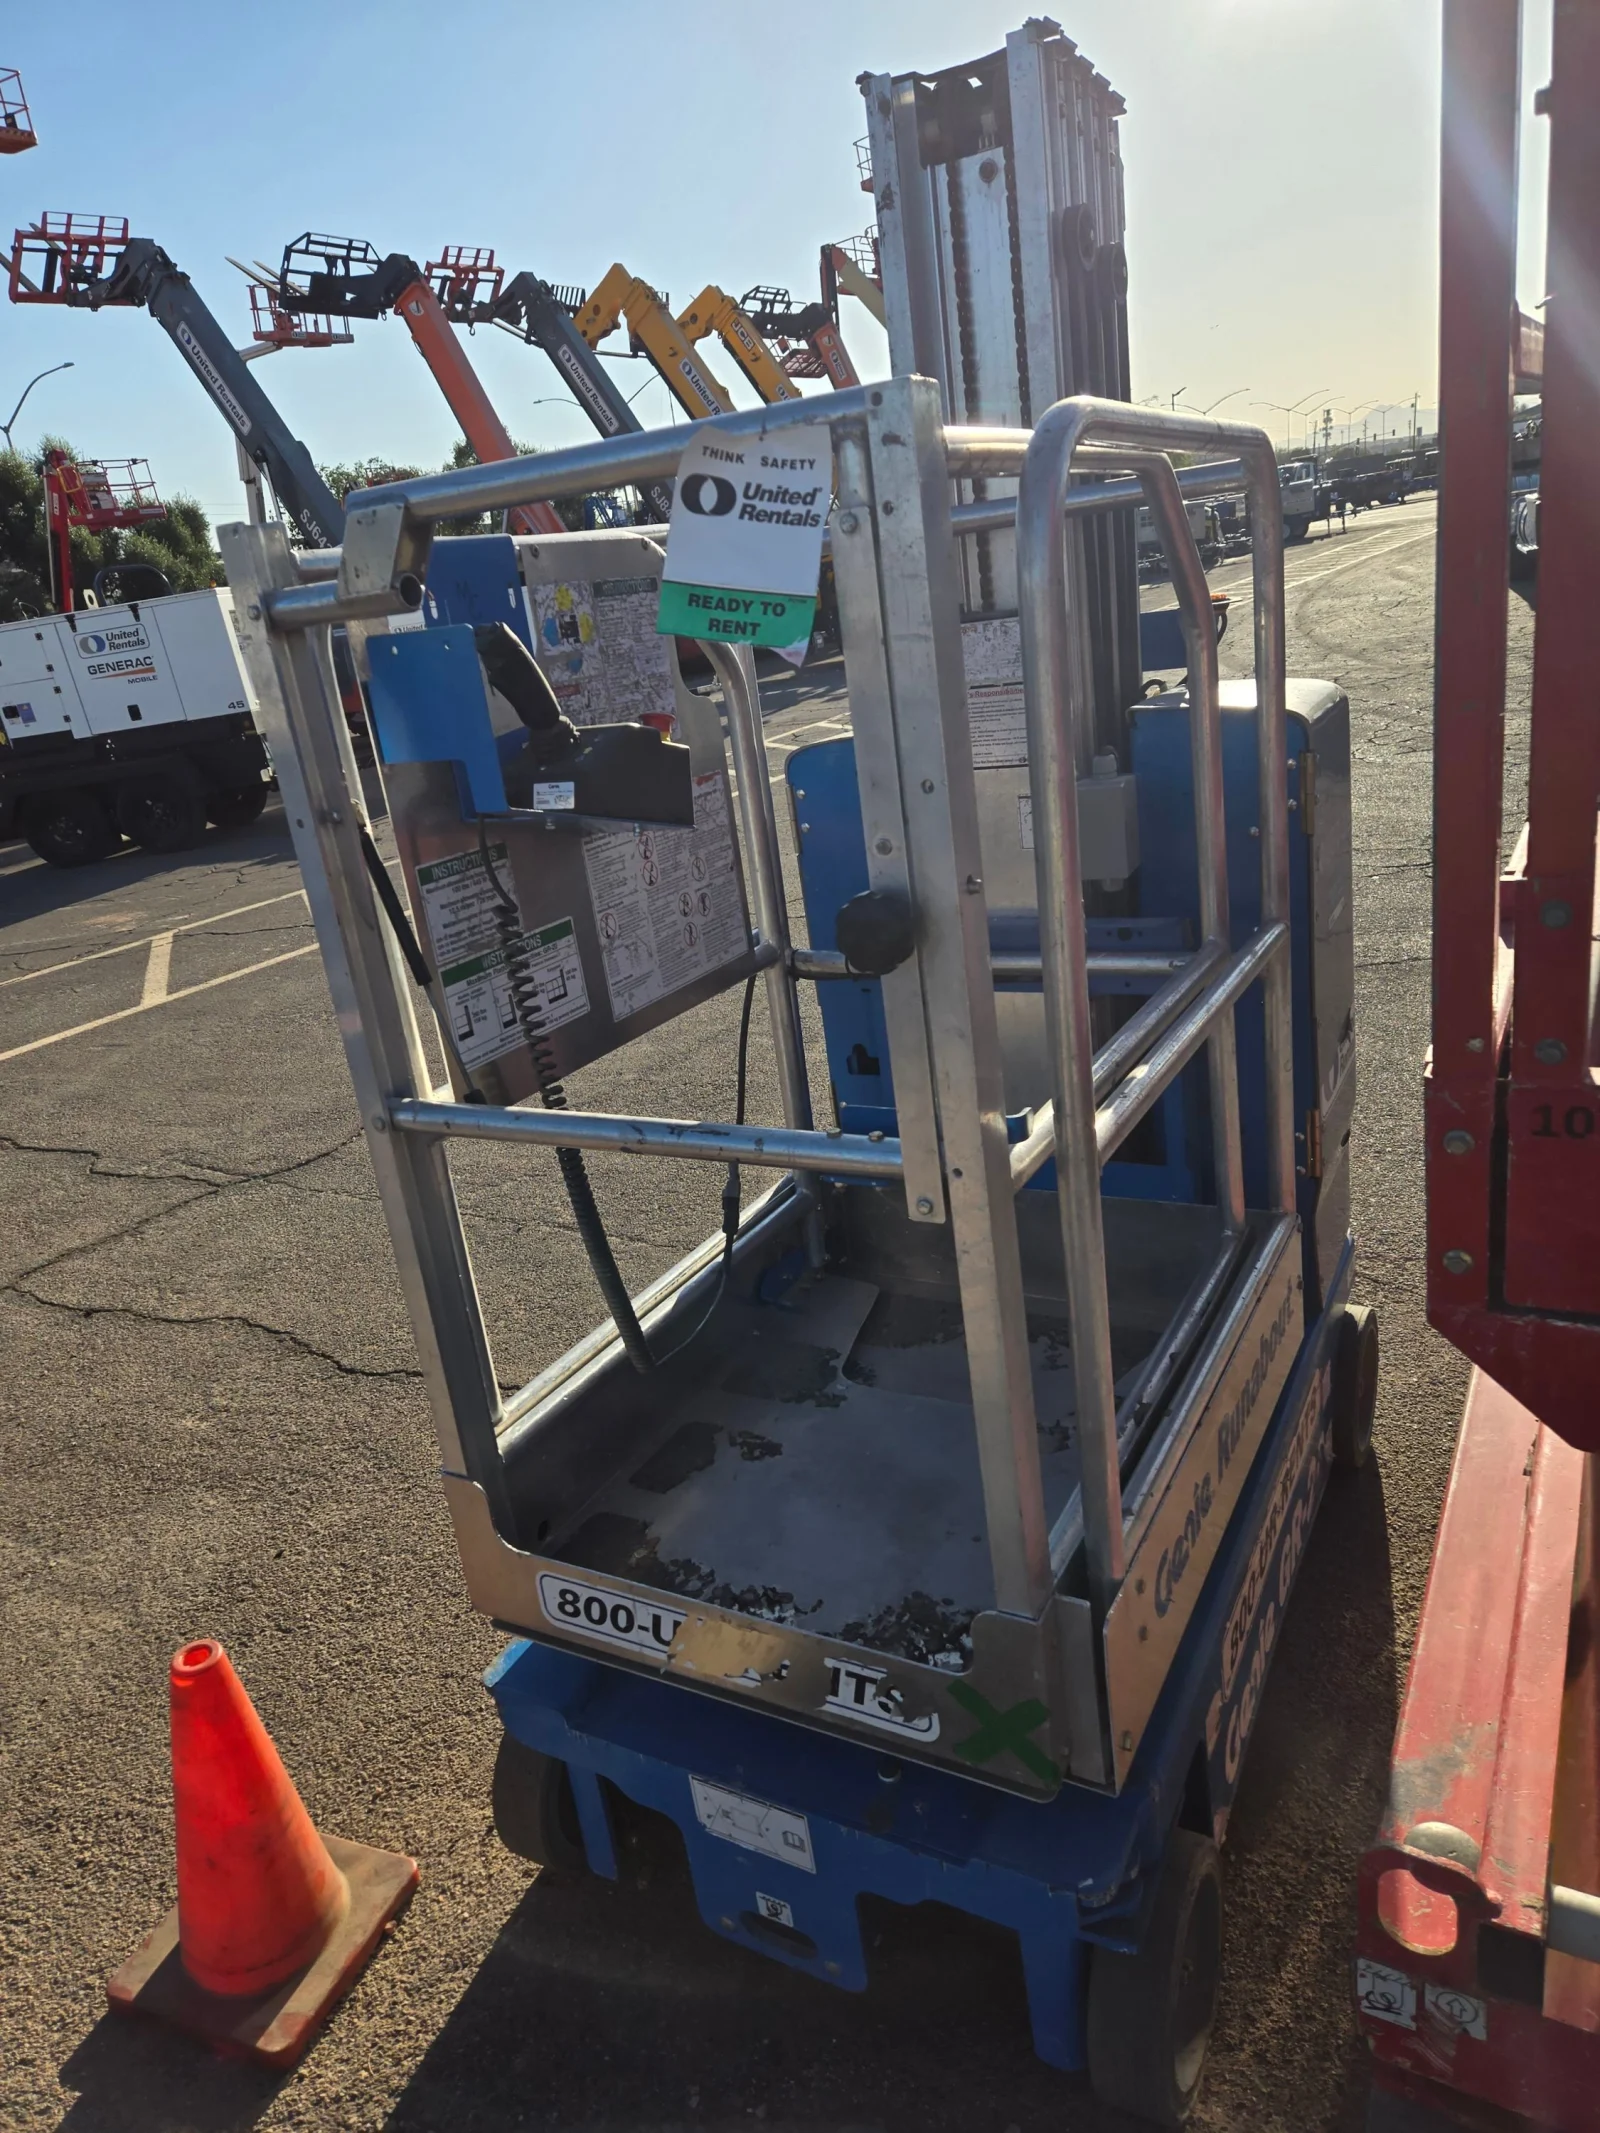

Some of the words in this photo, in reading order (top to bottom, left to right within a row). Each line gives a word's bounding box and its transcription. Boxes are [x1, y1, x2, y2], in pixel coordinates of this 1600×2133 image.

[732, 318, 756, 351] JCB
[191, 345, 219, 385] United
[217, 384, 247, 428] Rentals
[570, 363, 593, 394] United
[590, 393, 615, 427] Rentals
[691, 374, 716, 407] United
[702, 446, 745, 465] THINK
[760, 456, 817, 470] SAFETY
[743, 482, 819, 506] United
[738, 503, 821, 528] Rentals
[300, 509, 333, 549] SJ64
[687, 592, 754, 614] READY
[760, 601, 786, 617] TO
[106, 628, 139, 641] United
[708, 618, 761, 637] RENT
[108, 638, 145, 651] Rentals
[87, 656, 153, 675] GENERAC
[127, 674, 158, 684] MOBILE
[228, 700, 245, 710] 45
[431, 848, 498, 880] INSTRUCTIS
[1532, 1104, 1595, 1139] 10
[1154, 1472, 1213, 1620] Genie
[1217, 1279, 1295, 1484] Runabout
[1225, 1601, 1275, 1785] Genie
